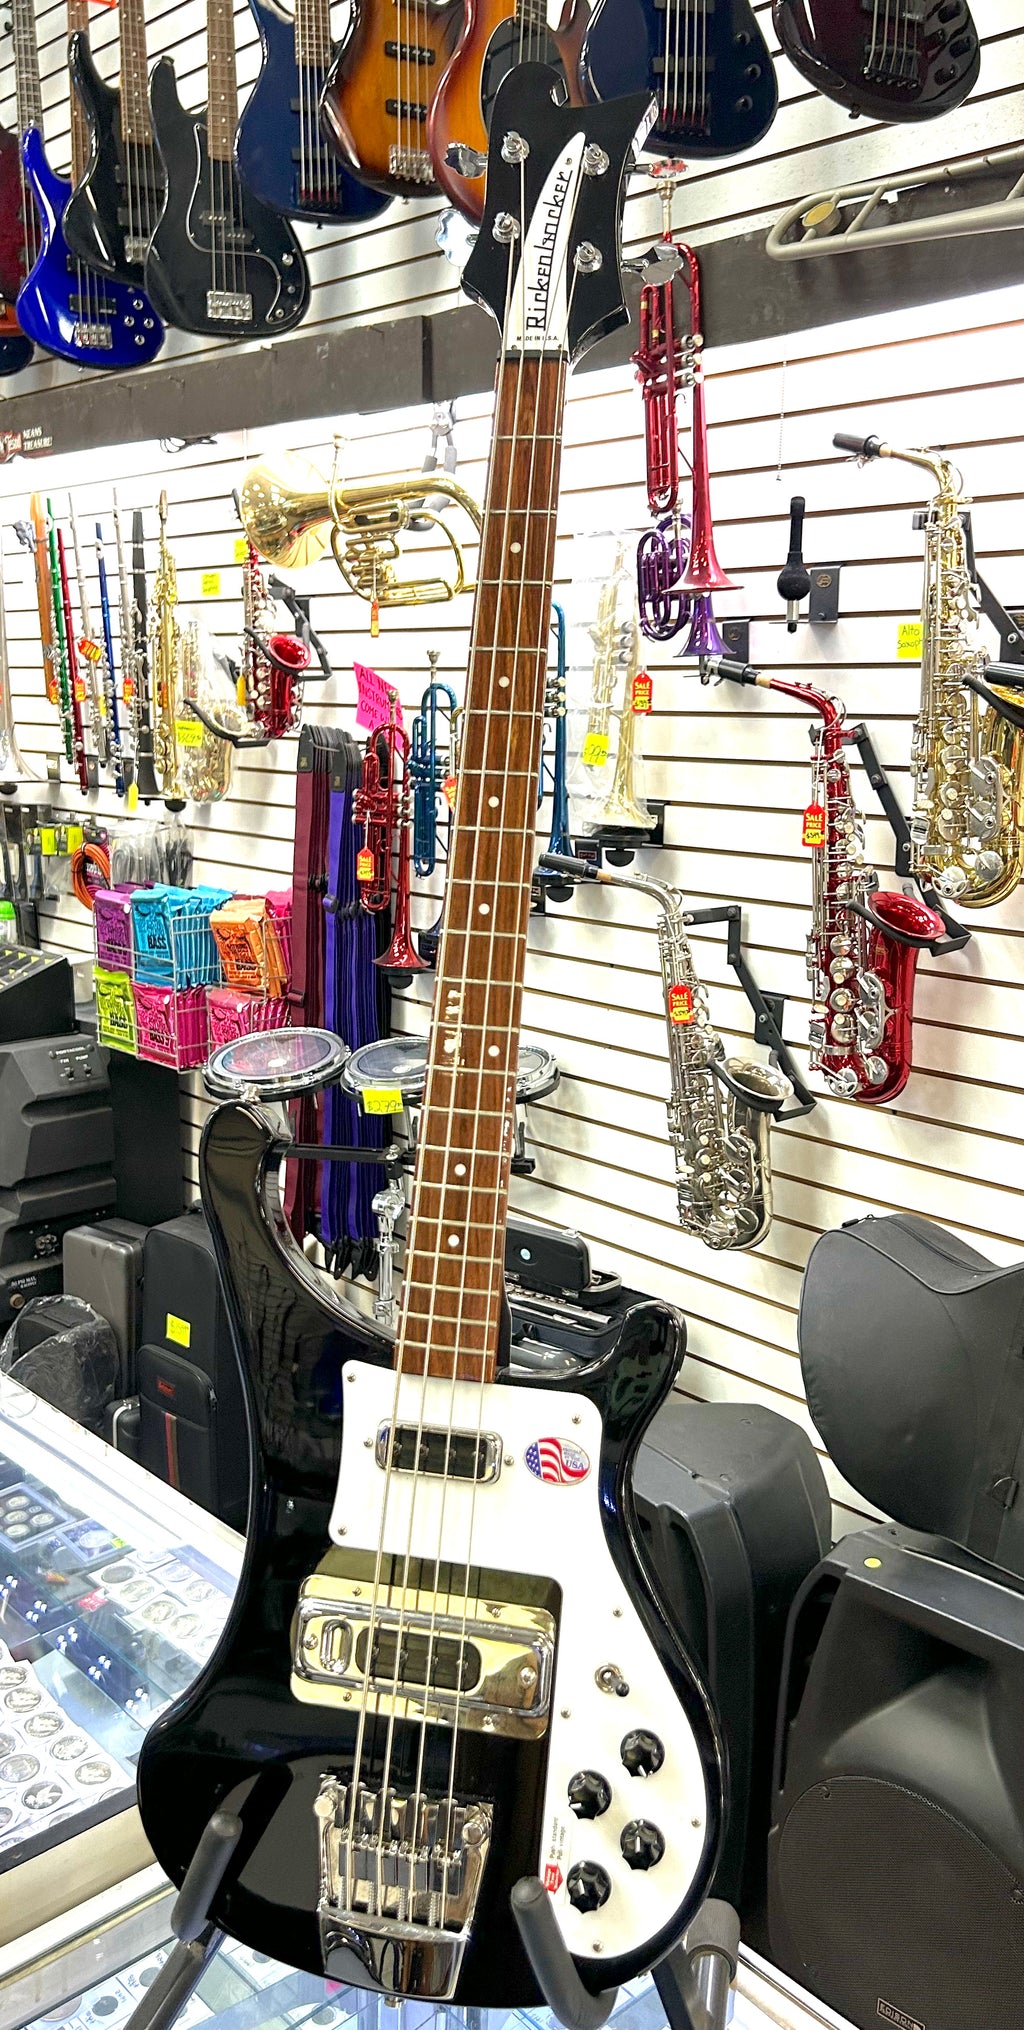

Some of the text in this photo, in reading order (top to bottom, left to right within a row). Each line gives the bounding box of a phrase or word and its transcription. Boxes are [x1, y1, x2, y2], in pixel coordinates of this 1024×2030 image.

[524, 169, 573, 331] Rickenbacker
[901, 624, 920, 636] Alto
[360, 668, 374, 687] ALL
[634, 682, 650, 690] SALE
[805, 812, 823, 821] SALE
[805, 821, 822, 829] PRICE
[148, 933, 167, 950] BASS
[671, 992, 689, 1001] SALE
[566, 1459, 585, 1470] USA
